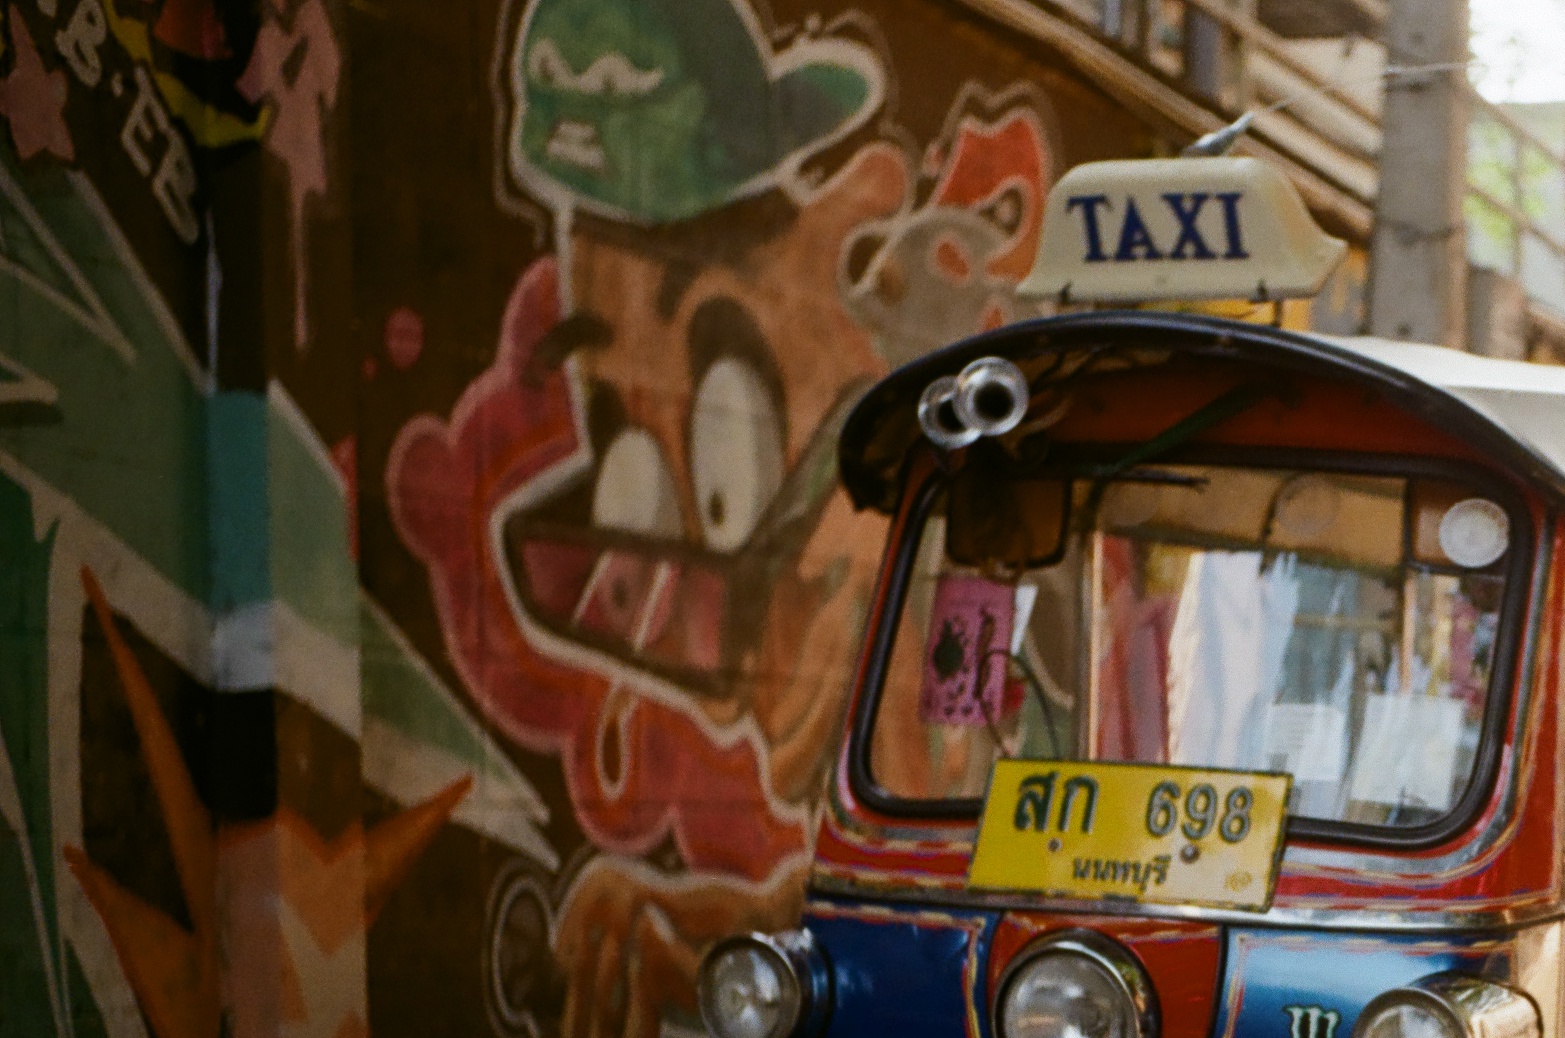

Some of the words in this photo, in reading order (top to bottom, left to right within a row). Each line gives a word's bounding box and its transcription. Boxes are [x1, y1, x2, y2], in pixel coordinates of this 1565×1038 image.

[1065, 192, 1251, 263] TAXI
[1013, 771, 1100, 834] สก
[1145, 781, 1254, 844] 698
[1073, 855, 1171, 892] นนทบุรี
